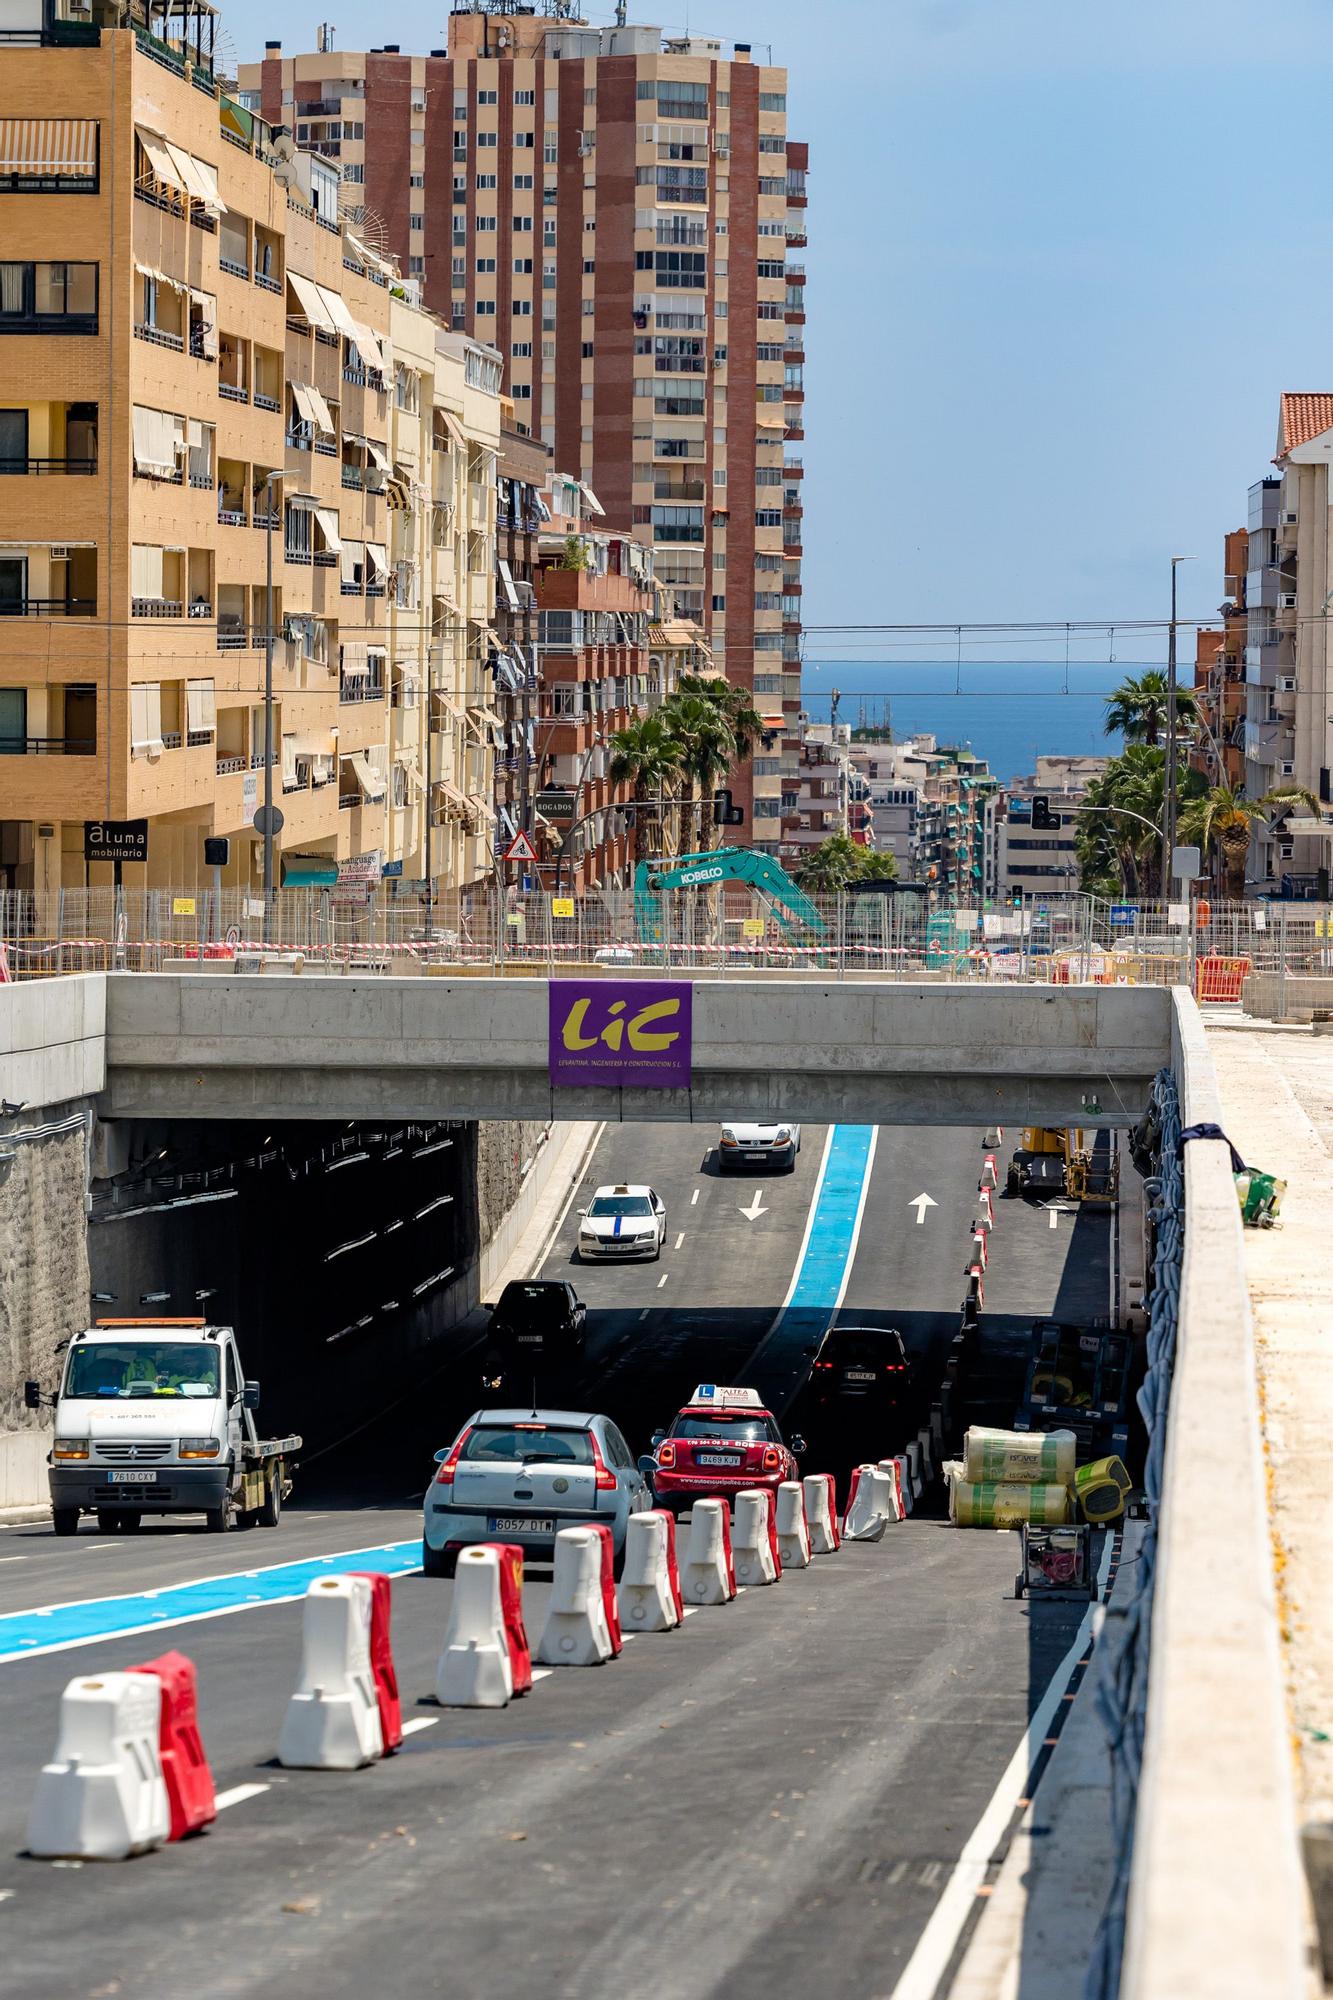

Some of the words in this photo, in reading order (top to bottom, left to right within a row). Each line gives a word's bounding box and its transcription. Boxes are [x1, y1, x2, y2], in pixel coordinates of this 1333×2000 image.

[536, 803, 572, 811] BOGADOS
[91, 849, 142, 857] mobiliario
[681, 867, 723, 885] KOBELCO
[702, 1386, 711, 1396] L
[702, 1455, 722, 1464] 9469
[114, 1472, 136, 1481] 7610
[137, 1472, 154, 1481] CXY
[497, 1519, 525, 1531] 6057
